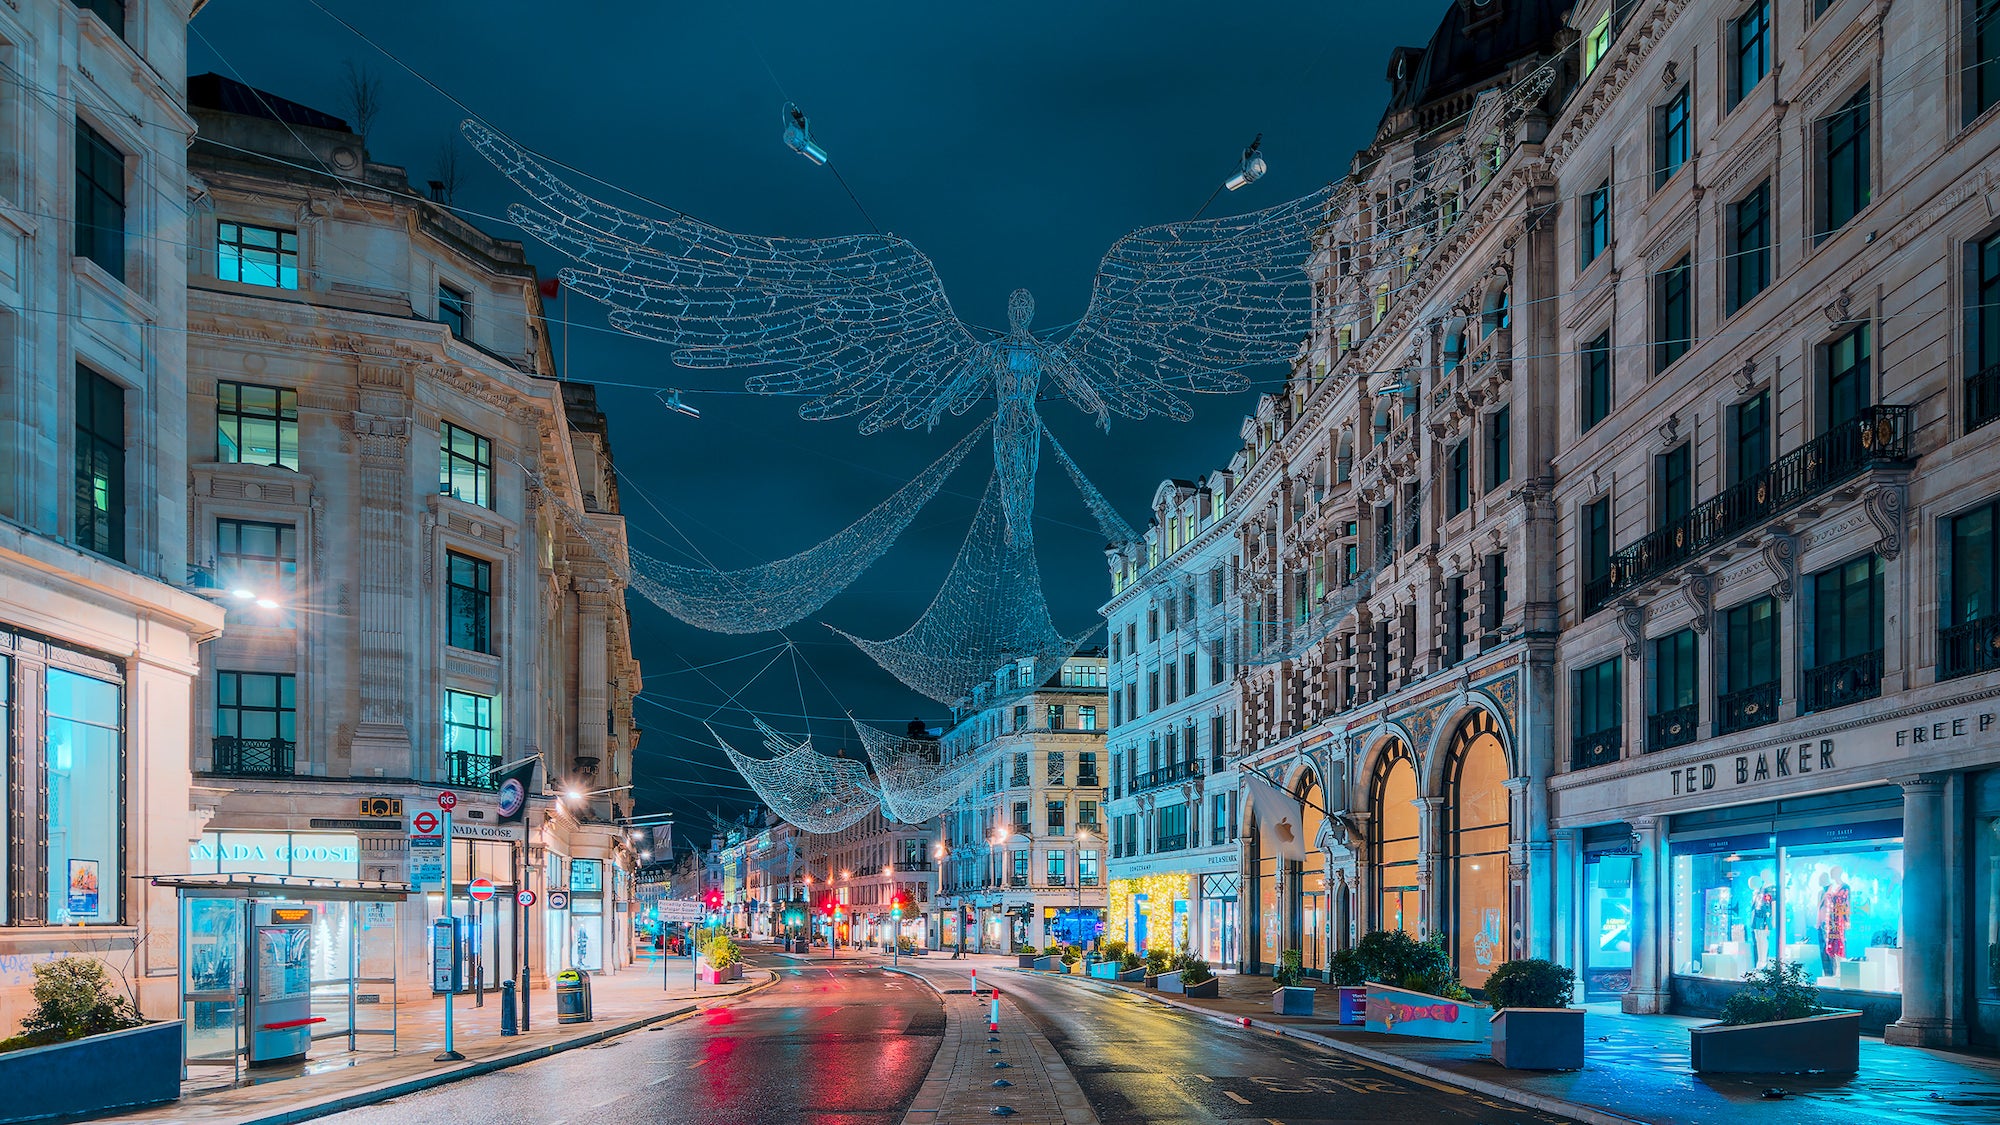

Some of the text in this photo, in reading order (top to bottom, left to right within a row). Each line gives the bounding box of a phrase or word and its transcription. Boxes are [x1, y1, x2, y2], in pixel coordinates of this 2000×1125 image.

[1896, 717, 1968, 747] FREE
[1670, 738, 1837, 796] TED BAKER
[440, 796, 454, 805] RG
[452, 825, 512, 838] NADA GOOSE
[190, 843, 359, 863] ANADA GOOSE
[519, 894, 532, 902] 20
